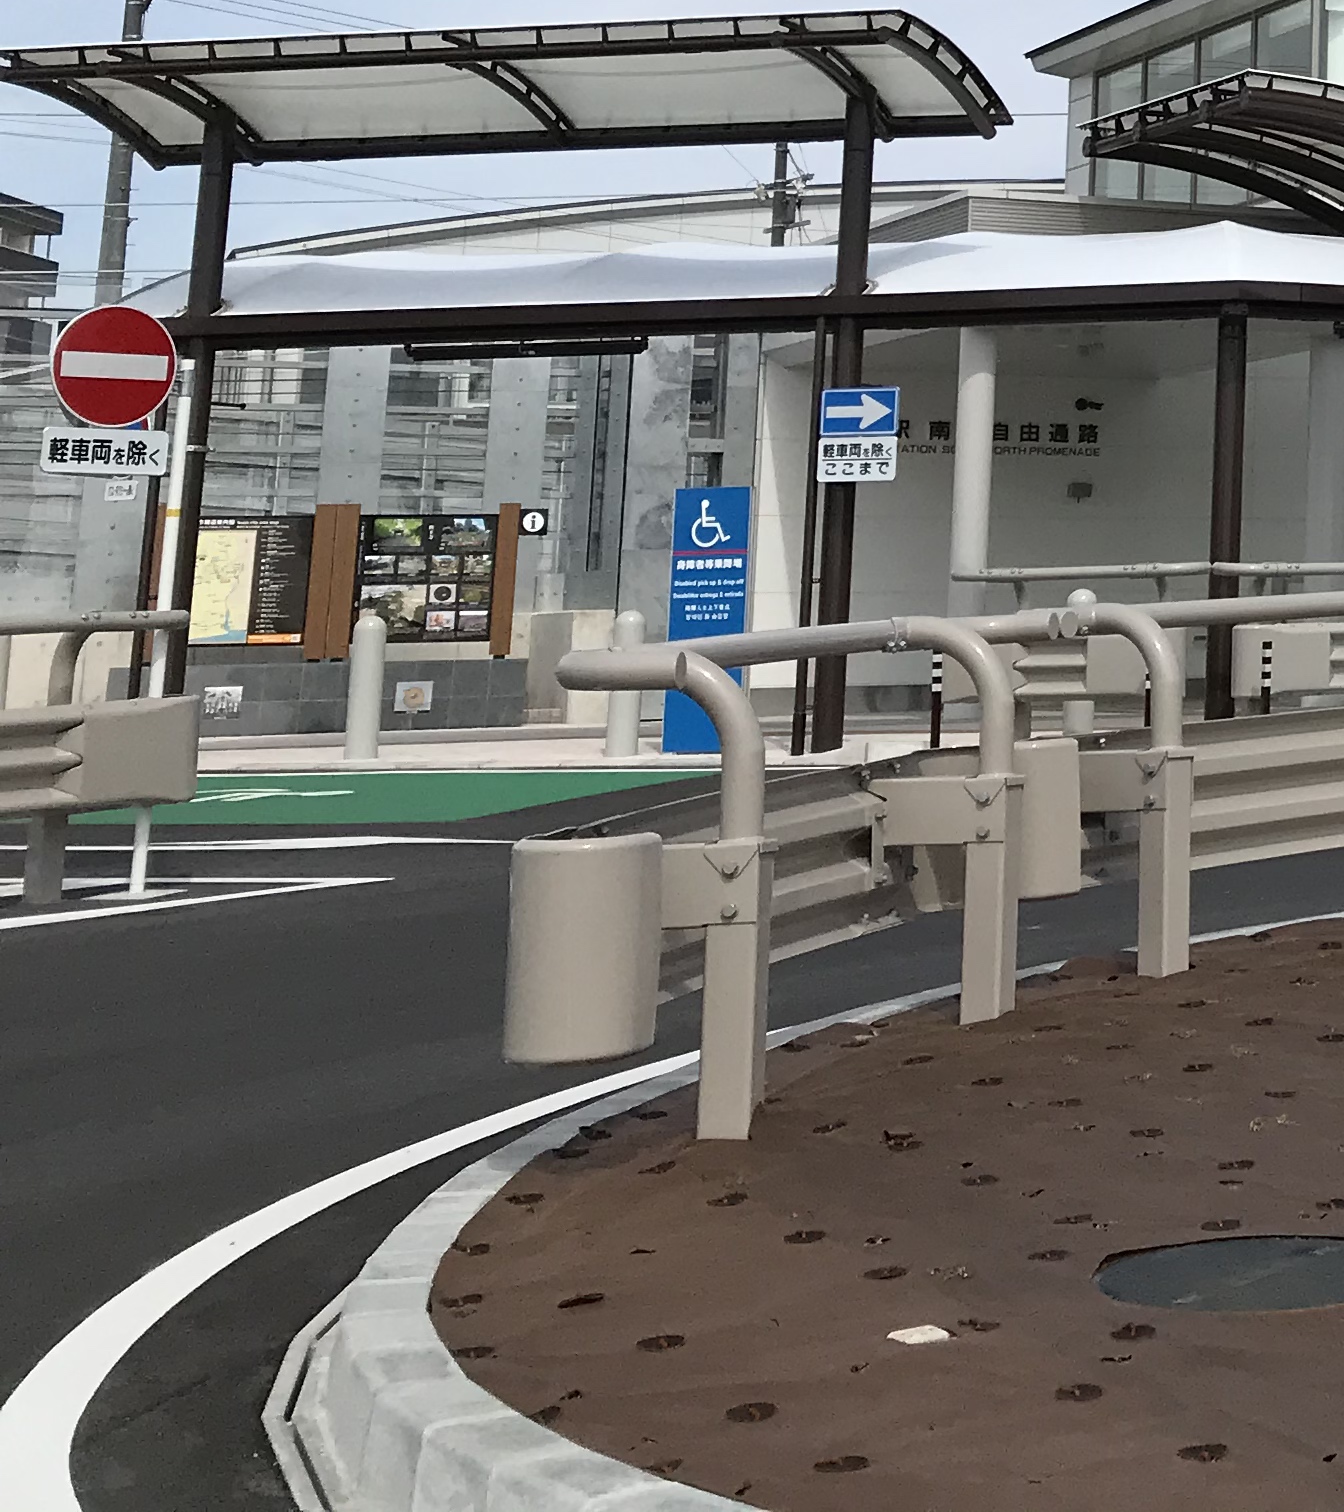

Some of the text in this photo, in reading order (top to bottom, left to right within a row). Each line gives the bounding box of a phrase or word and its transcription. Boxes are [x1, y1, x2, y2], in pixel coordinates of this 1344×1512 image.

[929, 420, 1099, 444] 南自由通路
[47, 437, 161, 467] 軽車両を除く
[822, 442, 893, 459] 軽車両を除く
[900, 444, 937, 454] ATION
[993, 446, 1027, 456] ORTH
[1028, 447, 1100, 457] PROMENADE
[824, 461, 890, 476] ここまで
